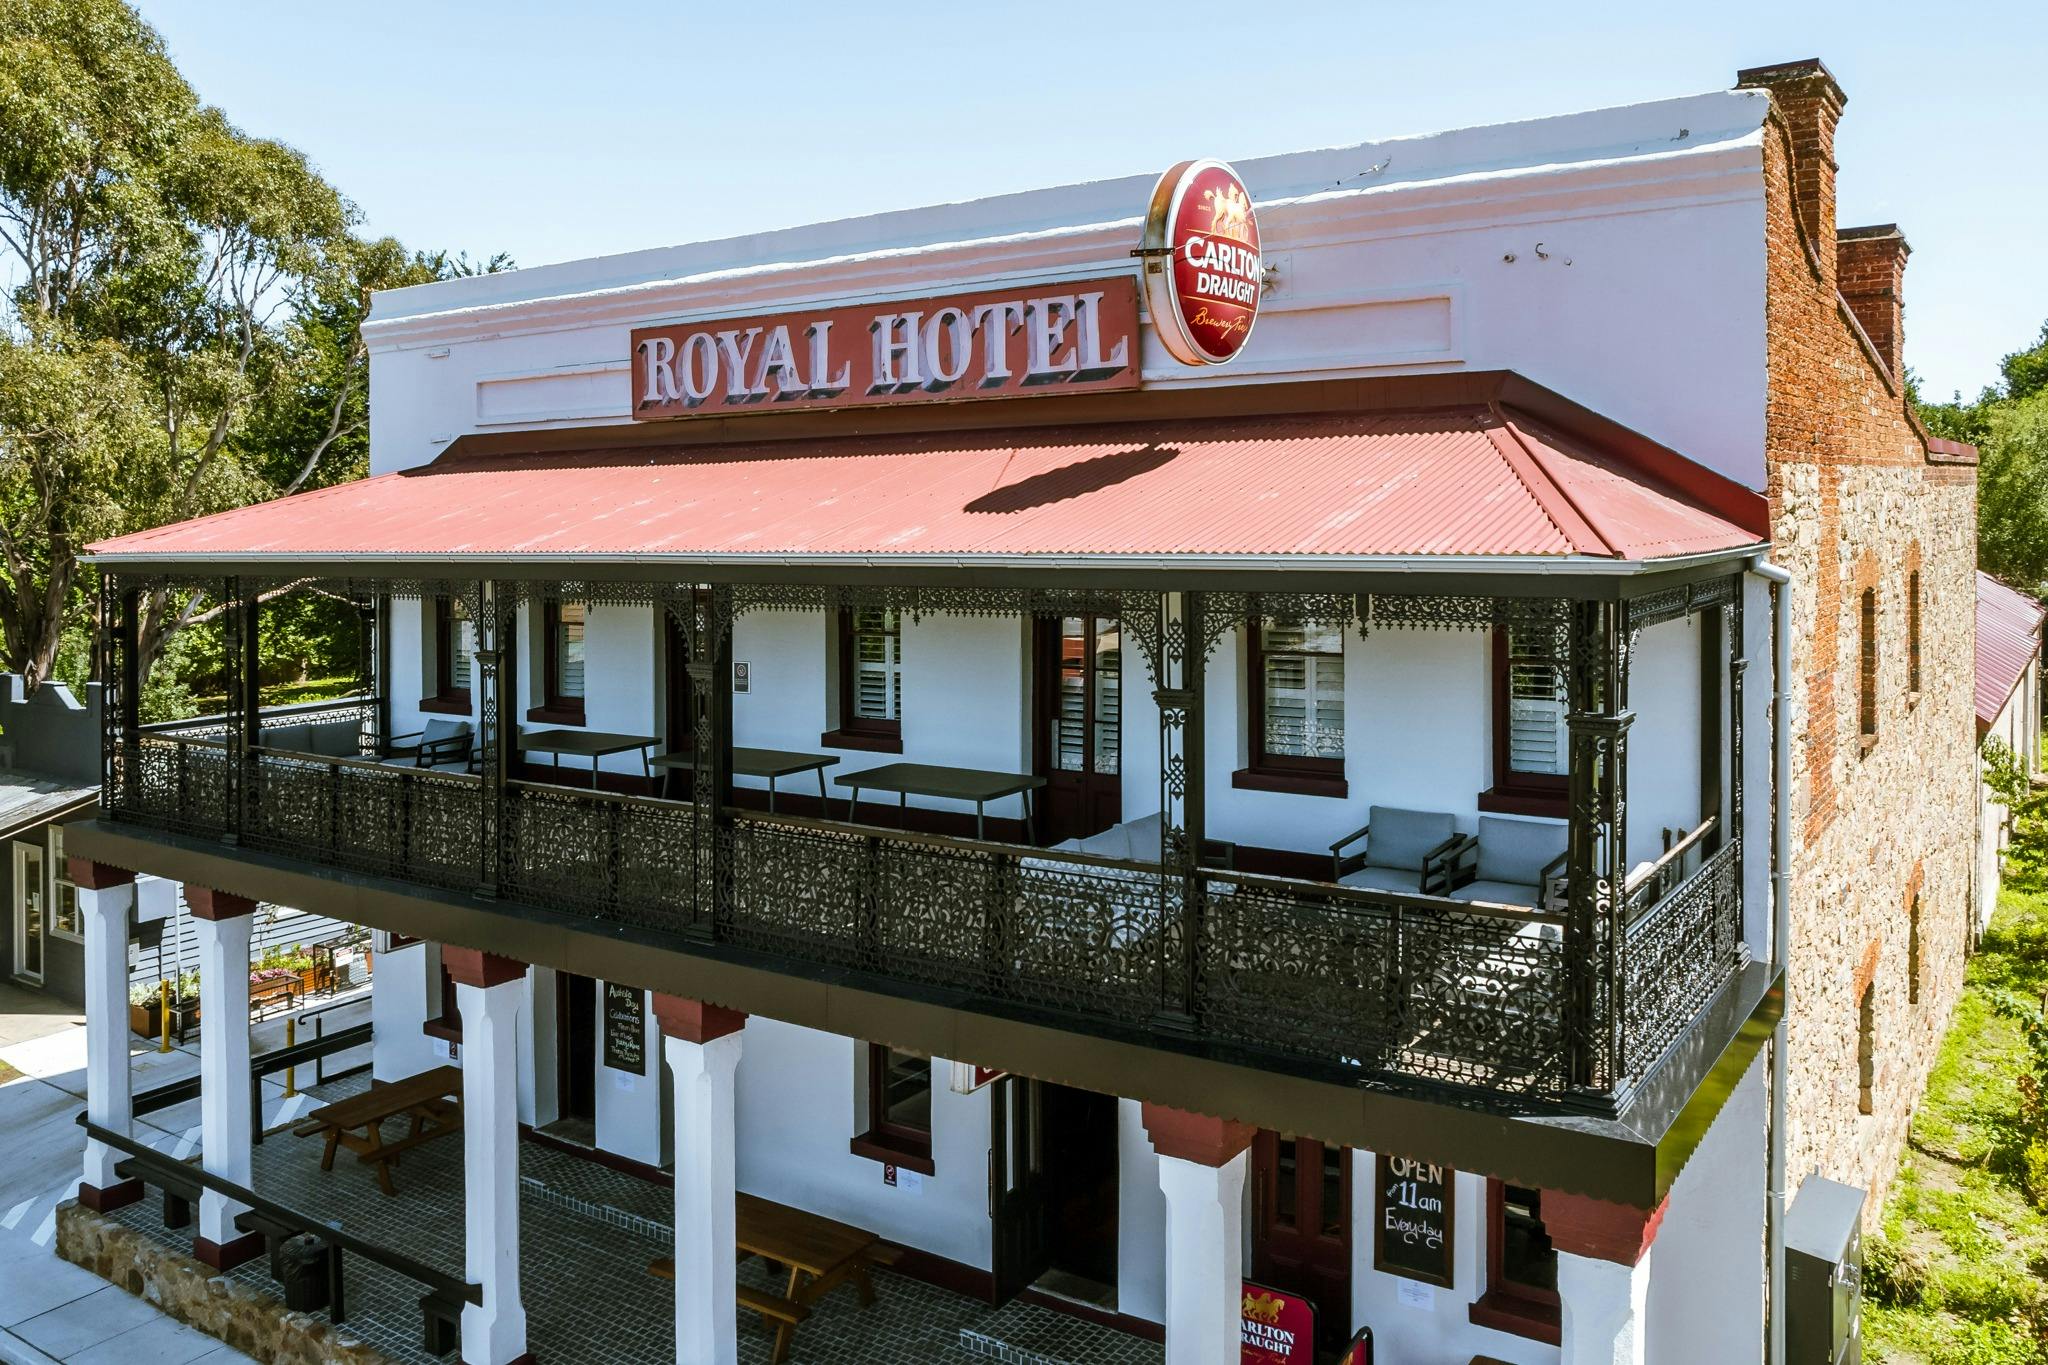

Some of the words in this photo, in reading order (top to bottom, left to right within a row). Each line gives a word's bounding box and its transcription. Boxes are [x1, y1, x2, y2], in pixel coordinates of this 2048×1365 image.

[1185, 236, 1260, 283] CARLTON
[1196, 271, 1255, 305] DRAUGHT
[1190, 306, 1233, 339] Brewery
[638, 320, 850, 408] ROYAL
[866, 291, 1129, 394] HOTEL
[625, 998, 640, 1014] Day
[1390, 1156, 1442, 1185] OPEN
[1399, 1181, 1441, 1213] 11am
[1385, 1207, 1443, 1249] Everyday
[1241, 1319, 1294, 1345] ARLTON
[1241, 1331, 1292, 1356] RAUGHT
